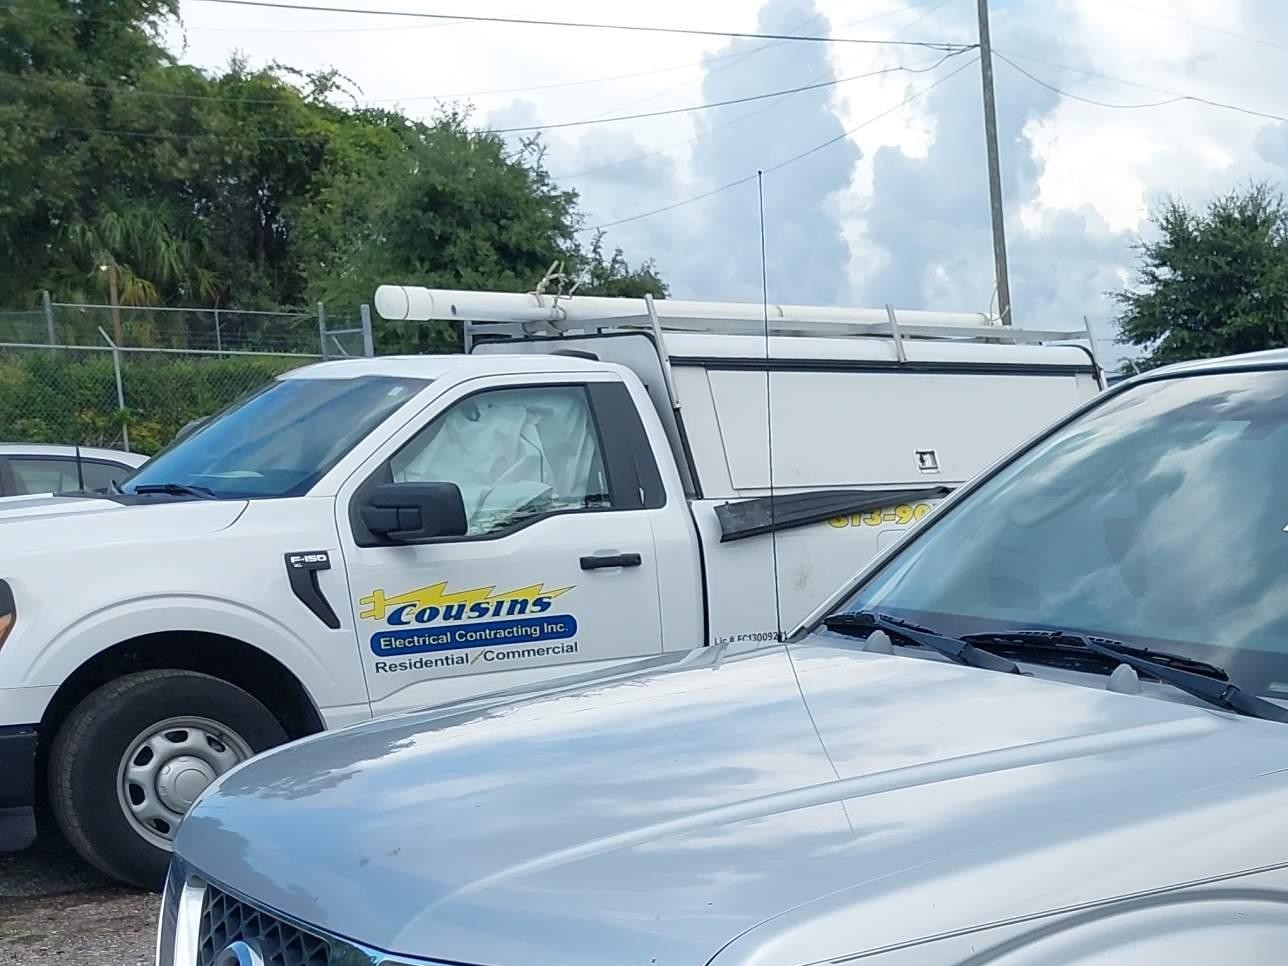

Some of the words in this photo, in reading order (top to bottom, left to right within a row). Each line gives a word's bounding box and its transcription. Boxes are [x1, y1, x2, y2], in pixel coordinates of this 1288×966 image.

[290, 554, 328, 563] F-150
[386, 595, 553, 626] Cousins
[379, 632, 451, 649] Electrical
[455, 625, 540, 642] Contracting
[544, 621, 569, 634] Inc.
